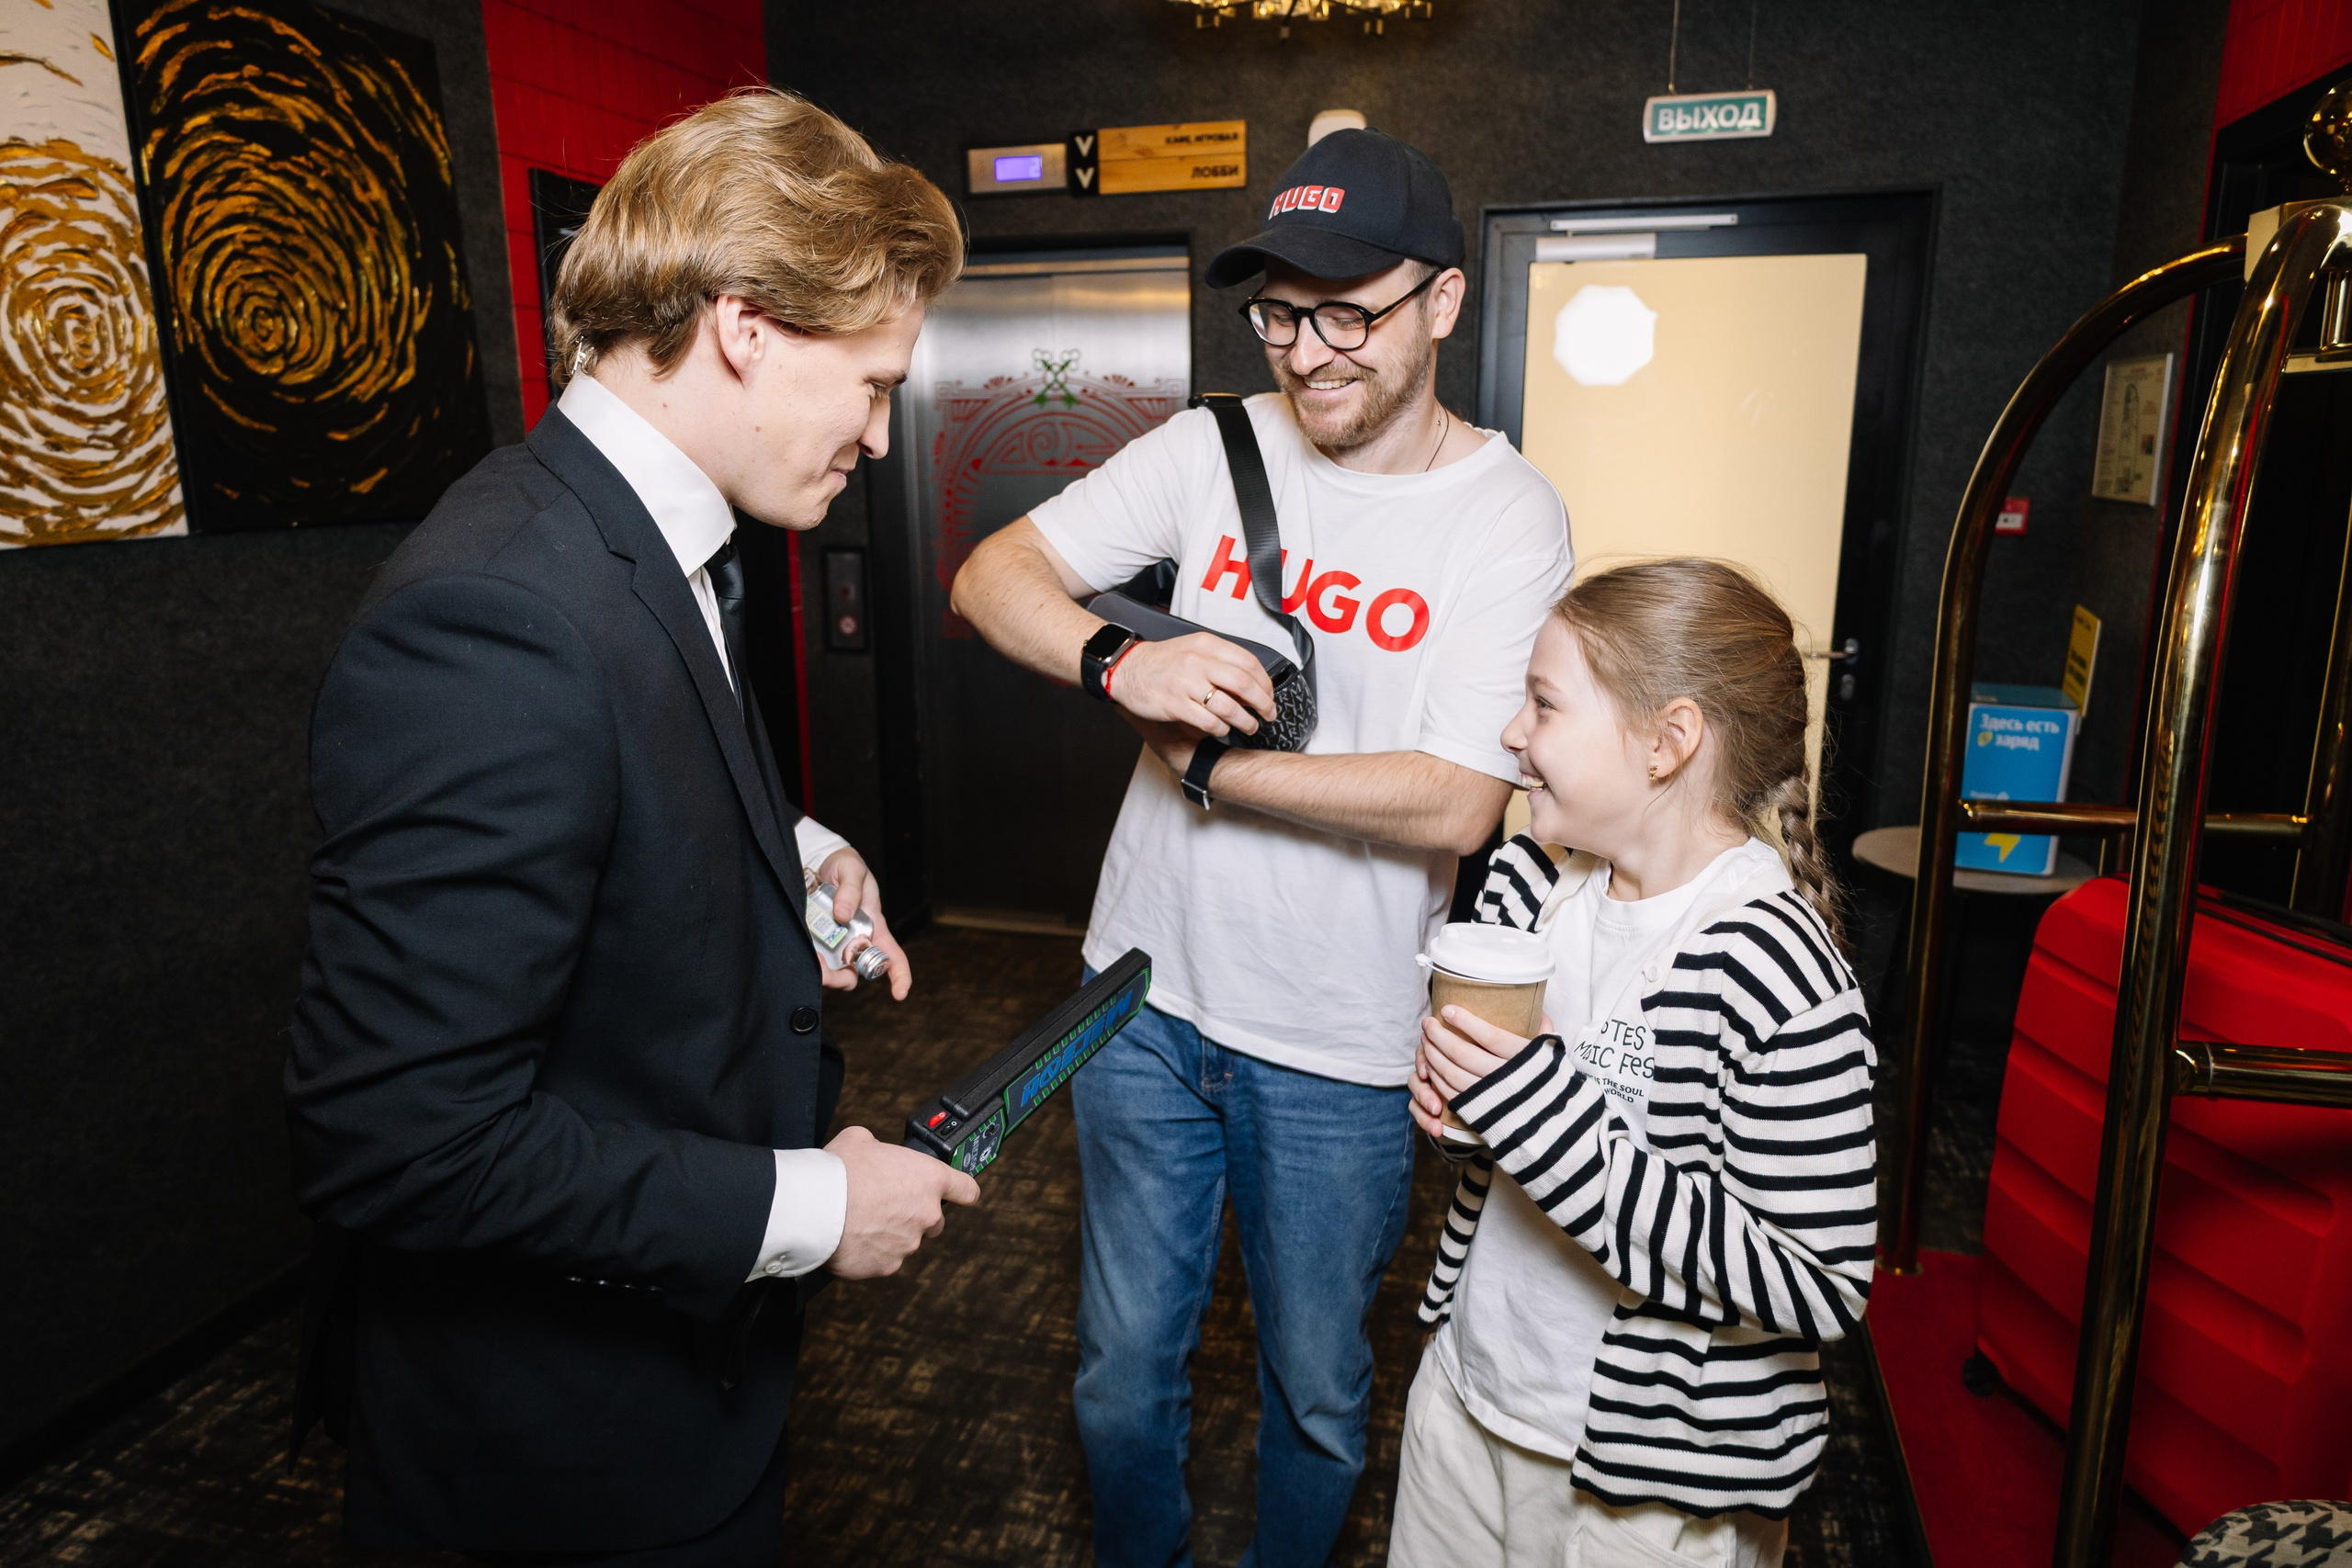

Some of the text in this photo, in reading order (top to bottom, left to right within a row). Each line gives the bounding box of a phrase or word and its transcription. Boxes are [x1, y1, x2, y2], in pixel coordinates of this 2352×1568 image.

[1657, 103, 1761, 131] ВЫХОД
[1192, 165, 1238, 179] ЛОББИ
[1269, 186, 1345, 220] HUGO
[1980, 713, 2060, 734] Здесь есть
[1602, 1078, 1619, 1089] THE
[1620, 1085, 1645, 1098] SOUL
[1604, 1089, 1634, 1103] WORLD
